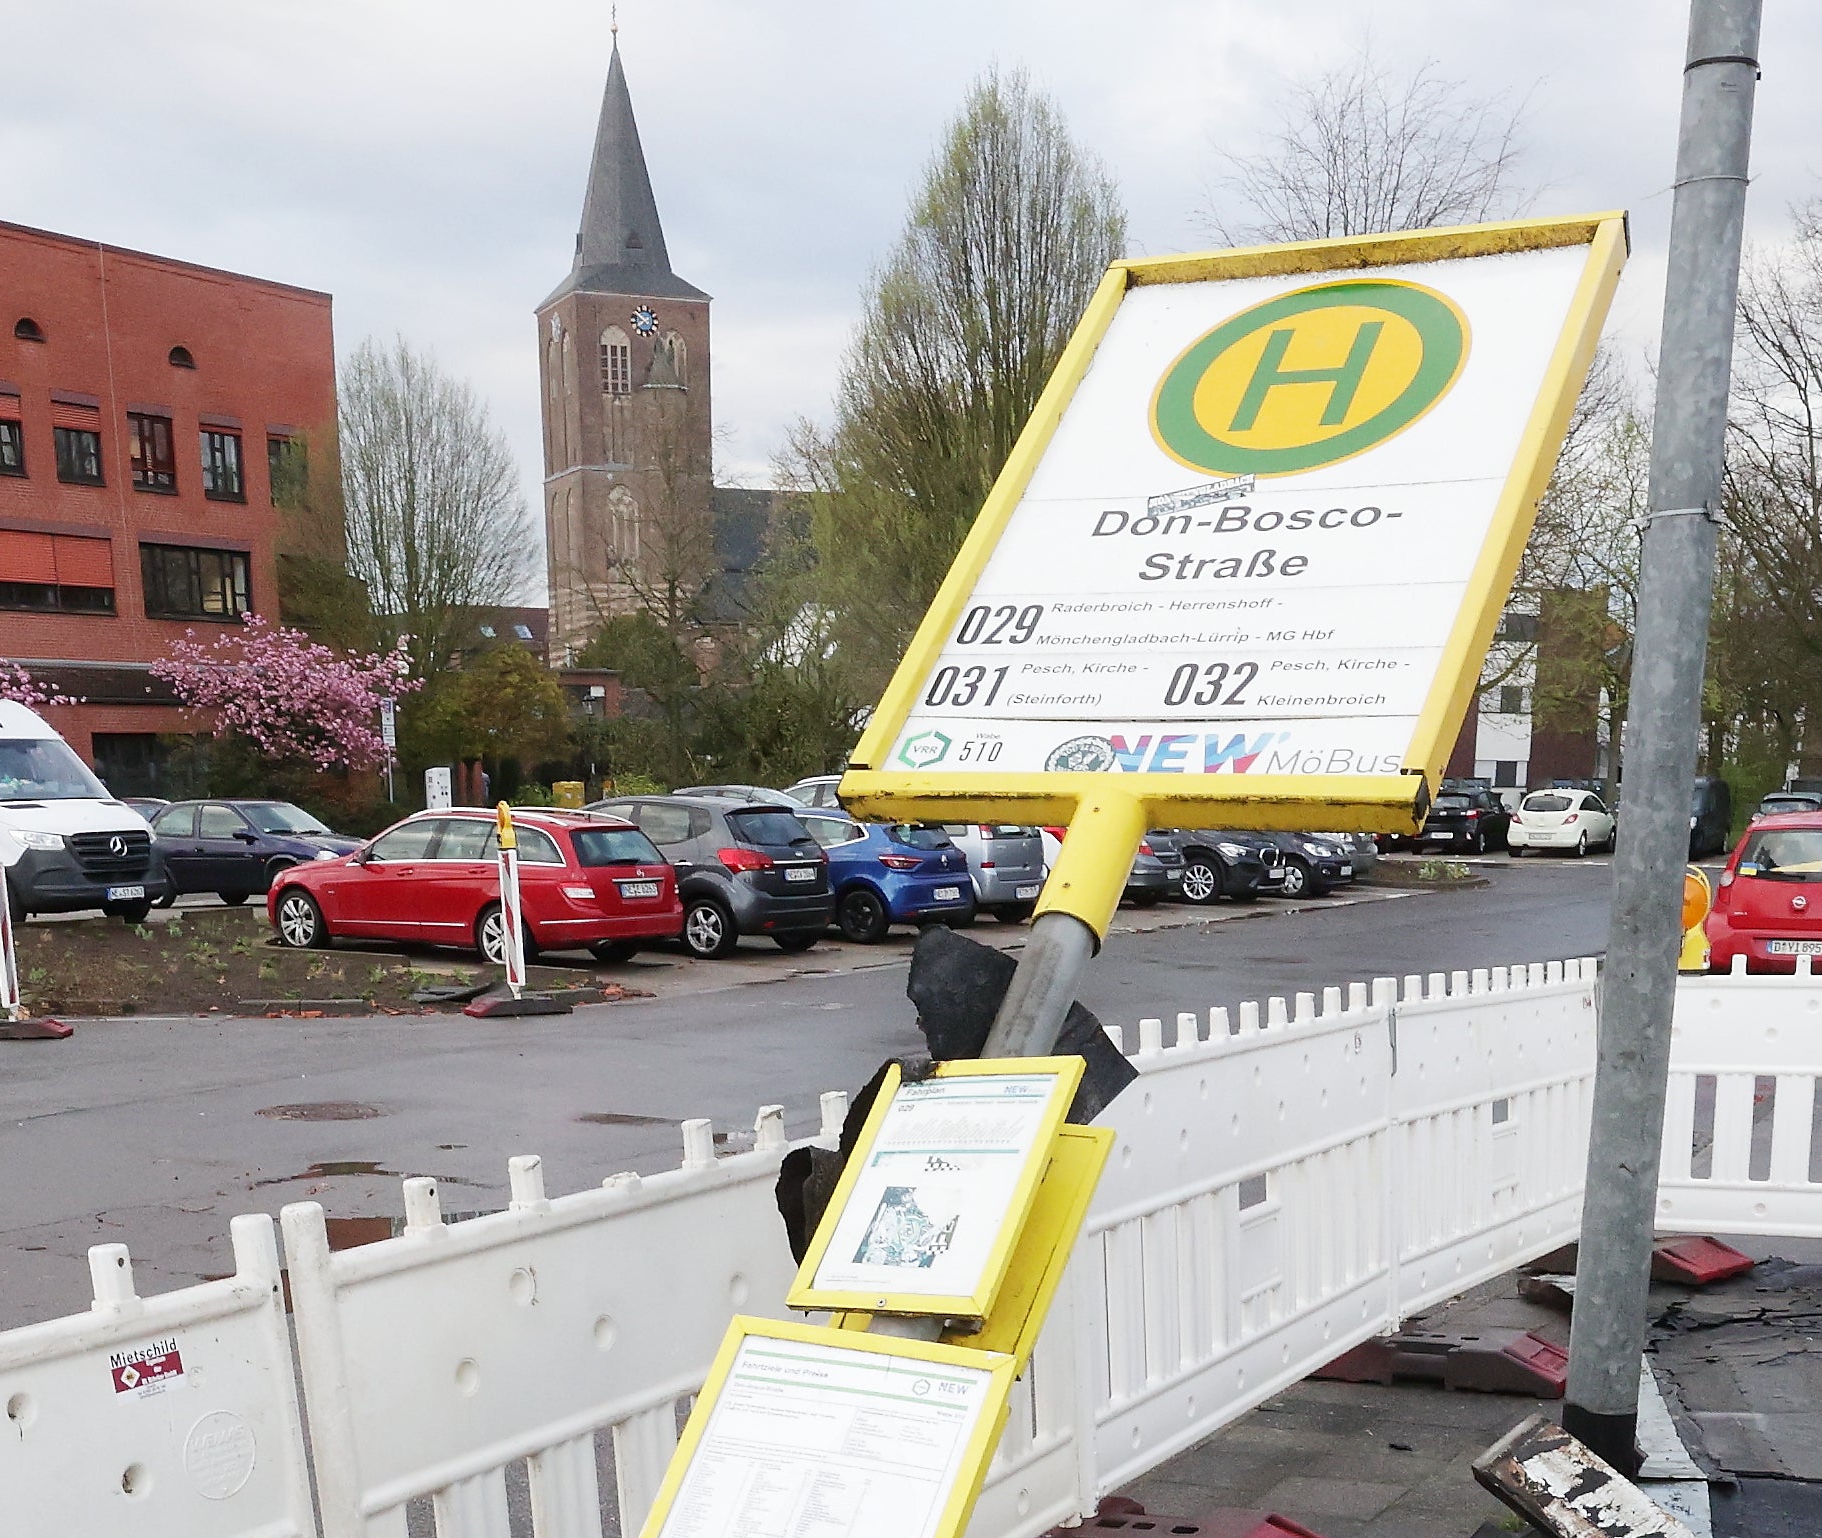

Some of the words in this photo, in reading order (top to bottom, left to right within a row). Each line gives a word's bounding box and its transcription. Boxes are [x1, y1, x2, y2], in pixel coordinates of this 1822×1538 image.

[1228, 320, 1385, 433] H
[1092, 505, 1403, 536] Don-Bosco-
[1138, 549, 1309, 580] Straße
[1051, 601, 1153, 613] Raderbroich
[1169, 597, 1274, 611] Herrenshoff
[956, 604, 1044, 645] 029
[1036, 630, 1249, 646] Mönchengladbach-Lürrip
[1266, 630, 1296, 642] MG
[1302, 629, 1335, 641] Hbf
[1021, 663, 1075, 674] Pesch,
[1082, 662, 1137, 673] Kirche
[1270, 659, 1330, 672] Pesch,
[1337, 658, 1398, 670] Kirche
[925, 664, 1010, 707] 031
[1163, 661, 1260, 707] 032
[1006, 693, 1102, 707] (Steinforth)
[1256, 693, 1386, 707] Kleinenbroich
[912, 745, 937, 754] VRR
[959, 741, 1003, 762] 510
[1108, 732, 1275, 774] NEW
[1266, 748, 1403, 775] MöBus
[110, 1338, 177, 1368] Mietschild
[938, 1381, 970, 1395] NEW
